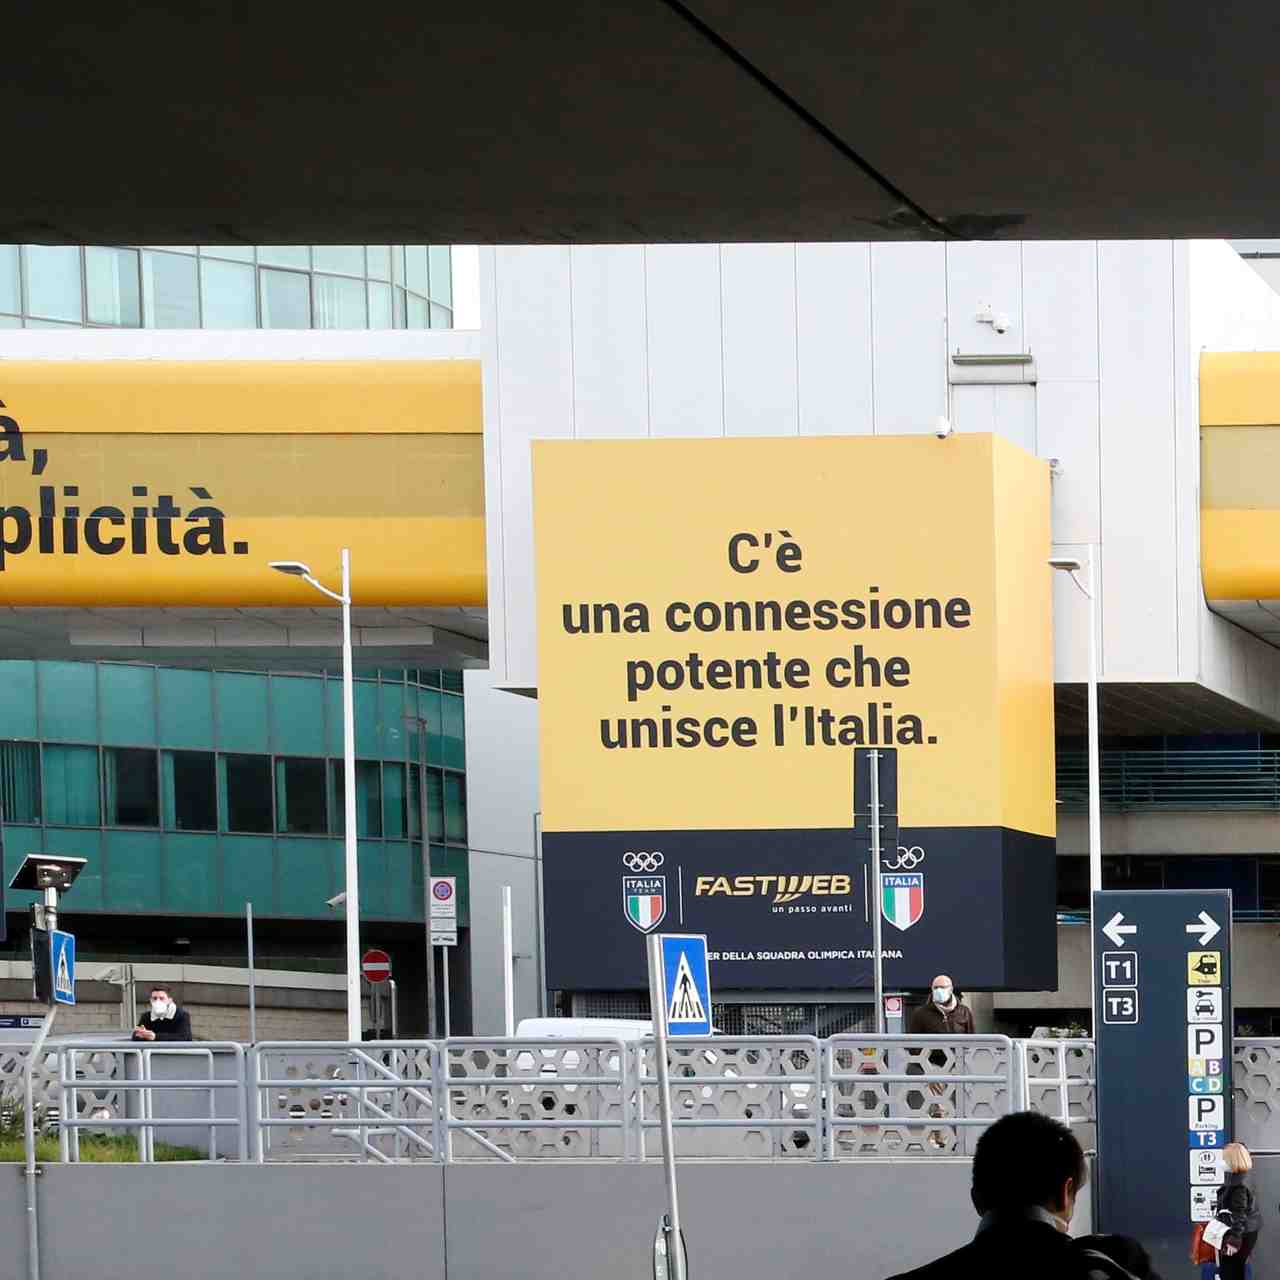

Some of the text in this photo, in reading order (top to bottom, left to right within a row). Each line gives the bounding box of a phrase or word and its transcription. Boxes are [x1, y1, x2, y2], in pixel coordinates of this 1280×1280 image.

[0, 485, 249, 571] plicità.
[728, 530, 802, 573] C'è
[562, 586, 971, 634] una connessione
[626, 645, 911, 701] potente che
[600, 702, 938, 749] unisce l'Italia.
[626, 880, 662, 889] ITALIA
[695, 875, 851, 903] FASTWEB
[884, 876, 919, 887] ITALIA
[772, 903, 852, 914] un passo avanti
[722, 951, 754, 961] DELLA
[757, 950, 805, 961] SQUADRA
[808, 949, 855, 960] OLIMPICA
[1106, 960, 1132, 979] T1
[1108, 997, 1134, 1015] T3
[1195, 1029, 1216, 1055] P
[1209, 1060, 1221, 1075] B
[1191, 1077, 1221, 1092] C D
[1197, 1097, 1216, 1122] P
[1196, 1132, 1217, 1146] T3
